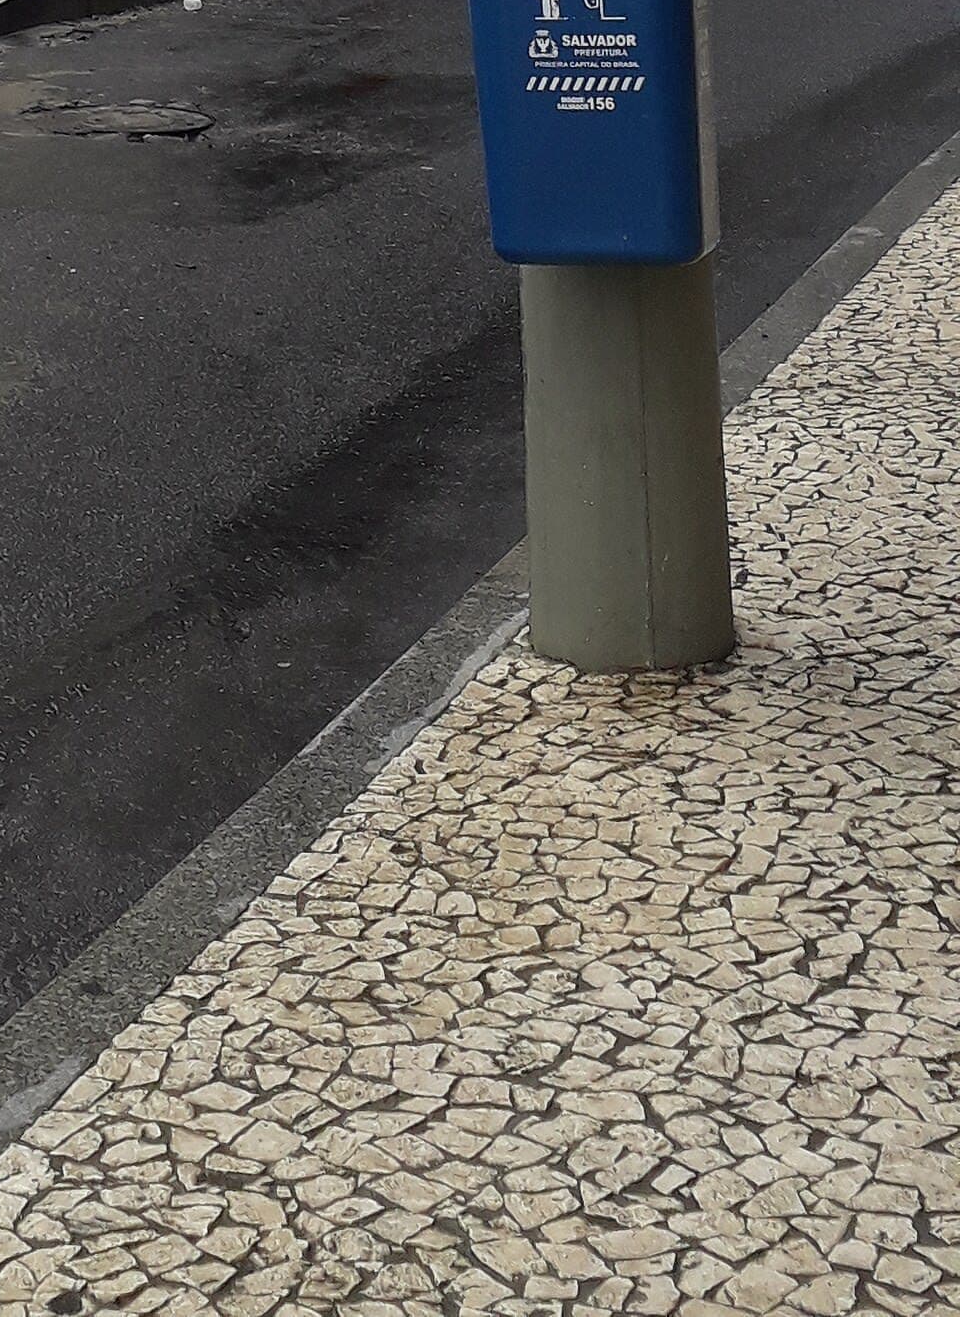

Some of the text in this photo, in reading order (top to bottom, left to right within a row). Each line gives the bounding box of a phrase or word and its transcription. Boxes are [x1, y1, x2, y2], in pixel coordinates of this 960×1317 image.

[561, 34, 637, 47] SALVADOR
[573, 48, 628, 57] PREFEITURA
[587, 97, 616, 110] 156
